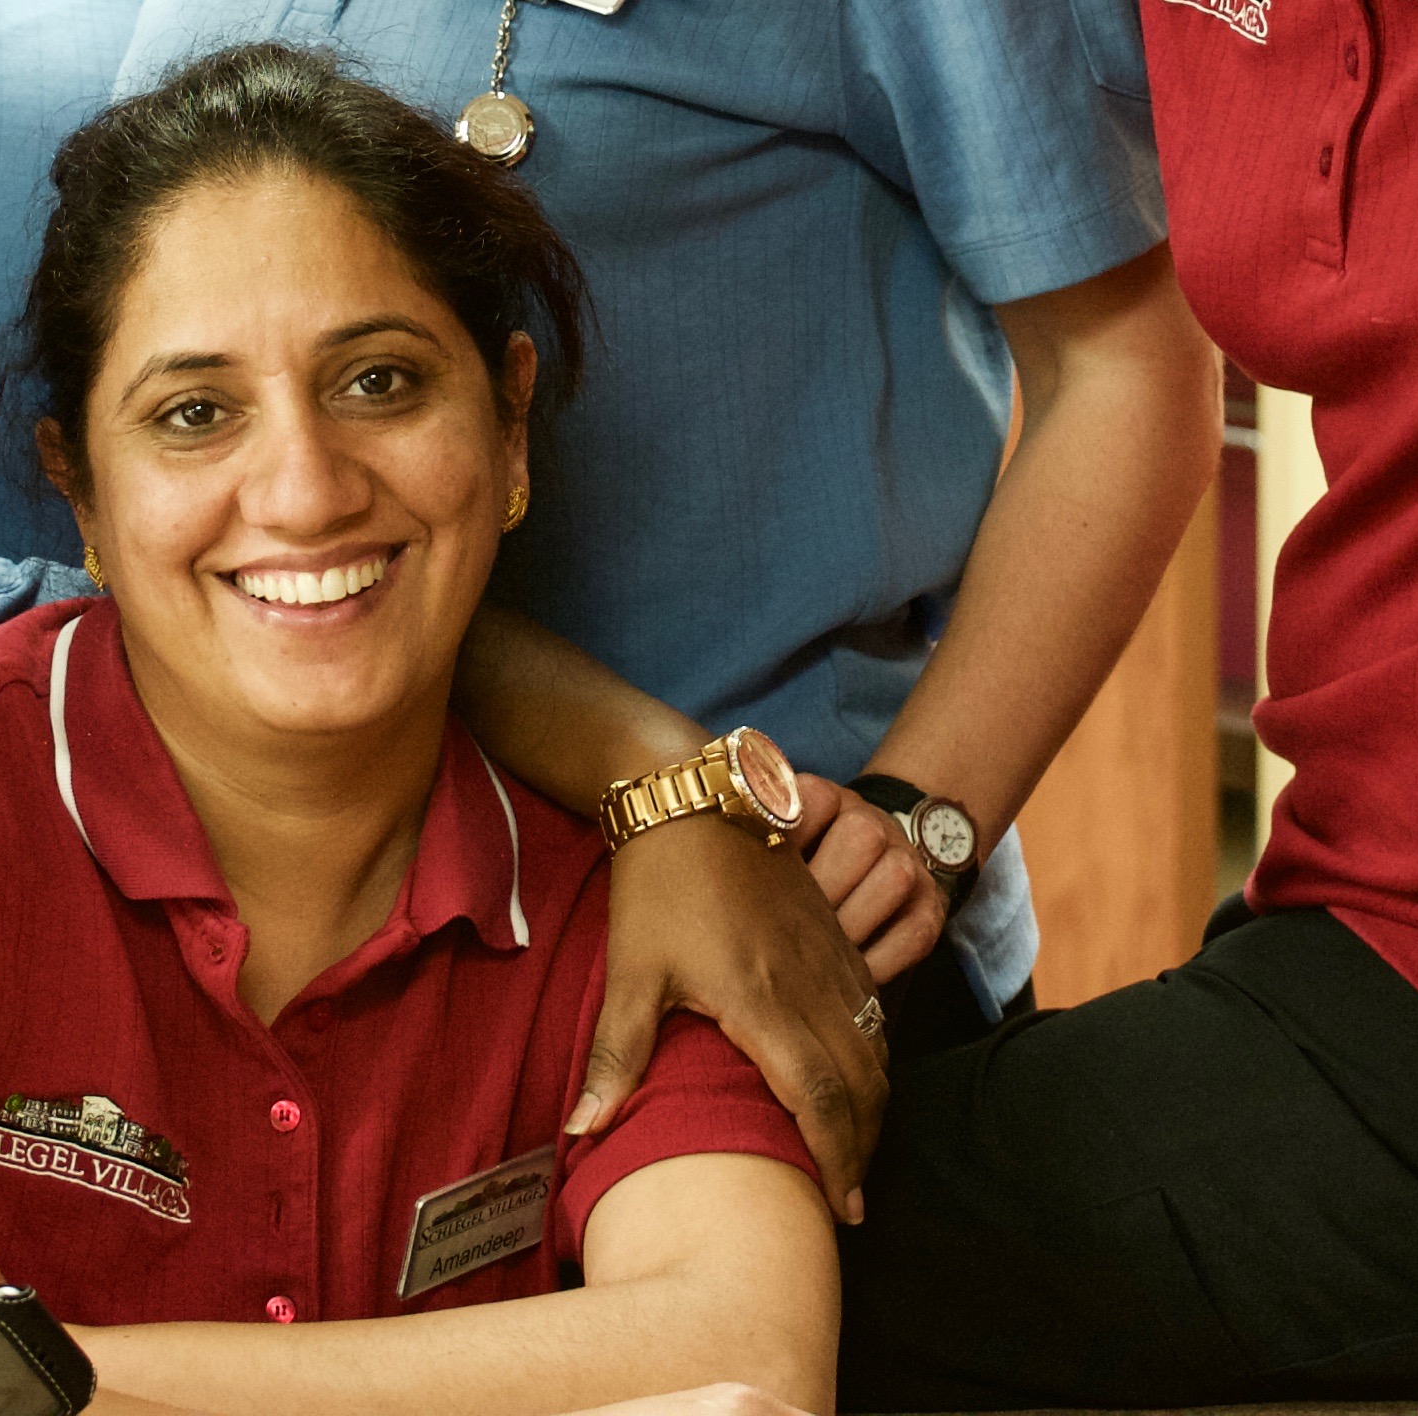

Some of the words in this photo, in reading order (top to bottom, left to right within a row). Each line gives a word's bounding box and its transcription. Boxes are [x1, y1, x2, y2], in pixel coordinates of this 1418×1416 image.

[417, 1213, 484, 1251] SCHLEGEL
[488, 1175, 551, 1218] VILLAGES
[429, 1225, 526, 1280] Amandeep
